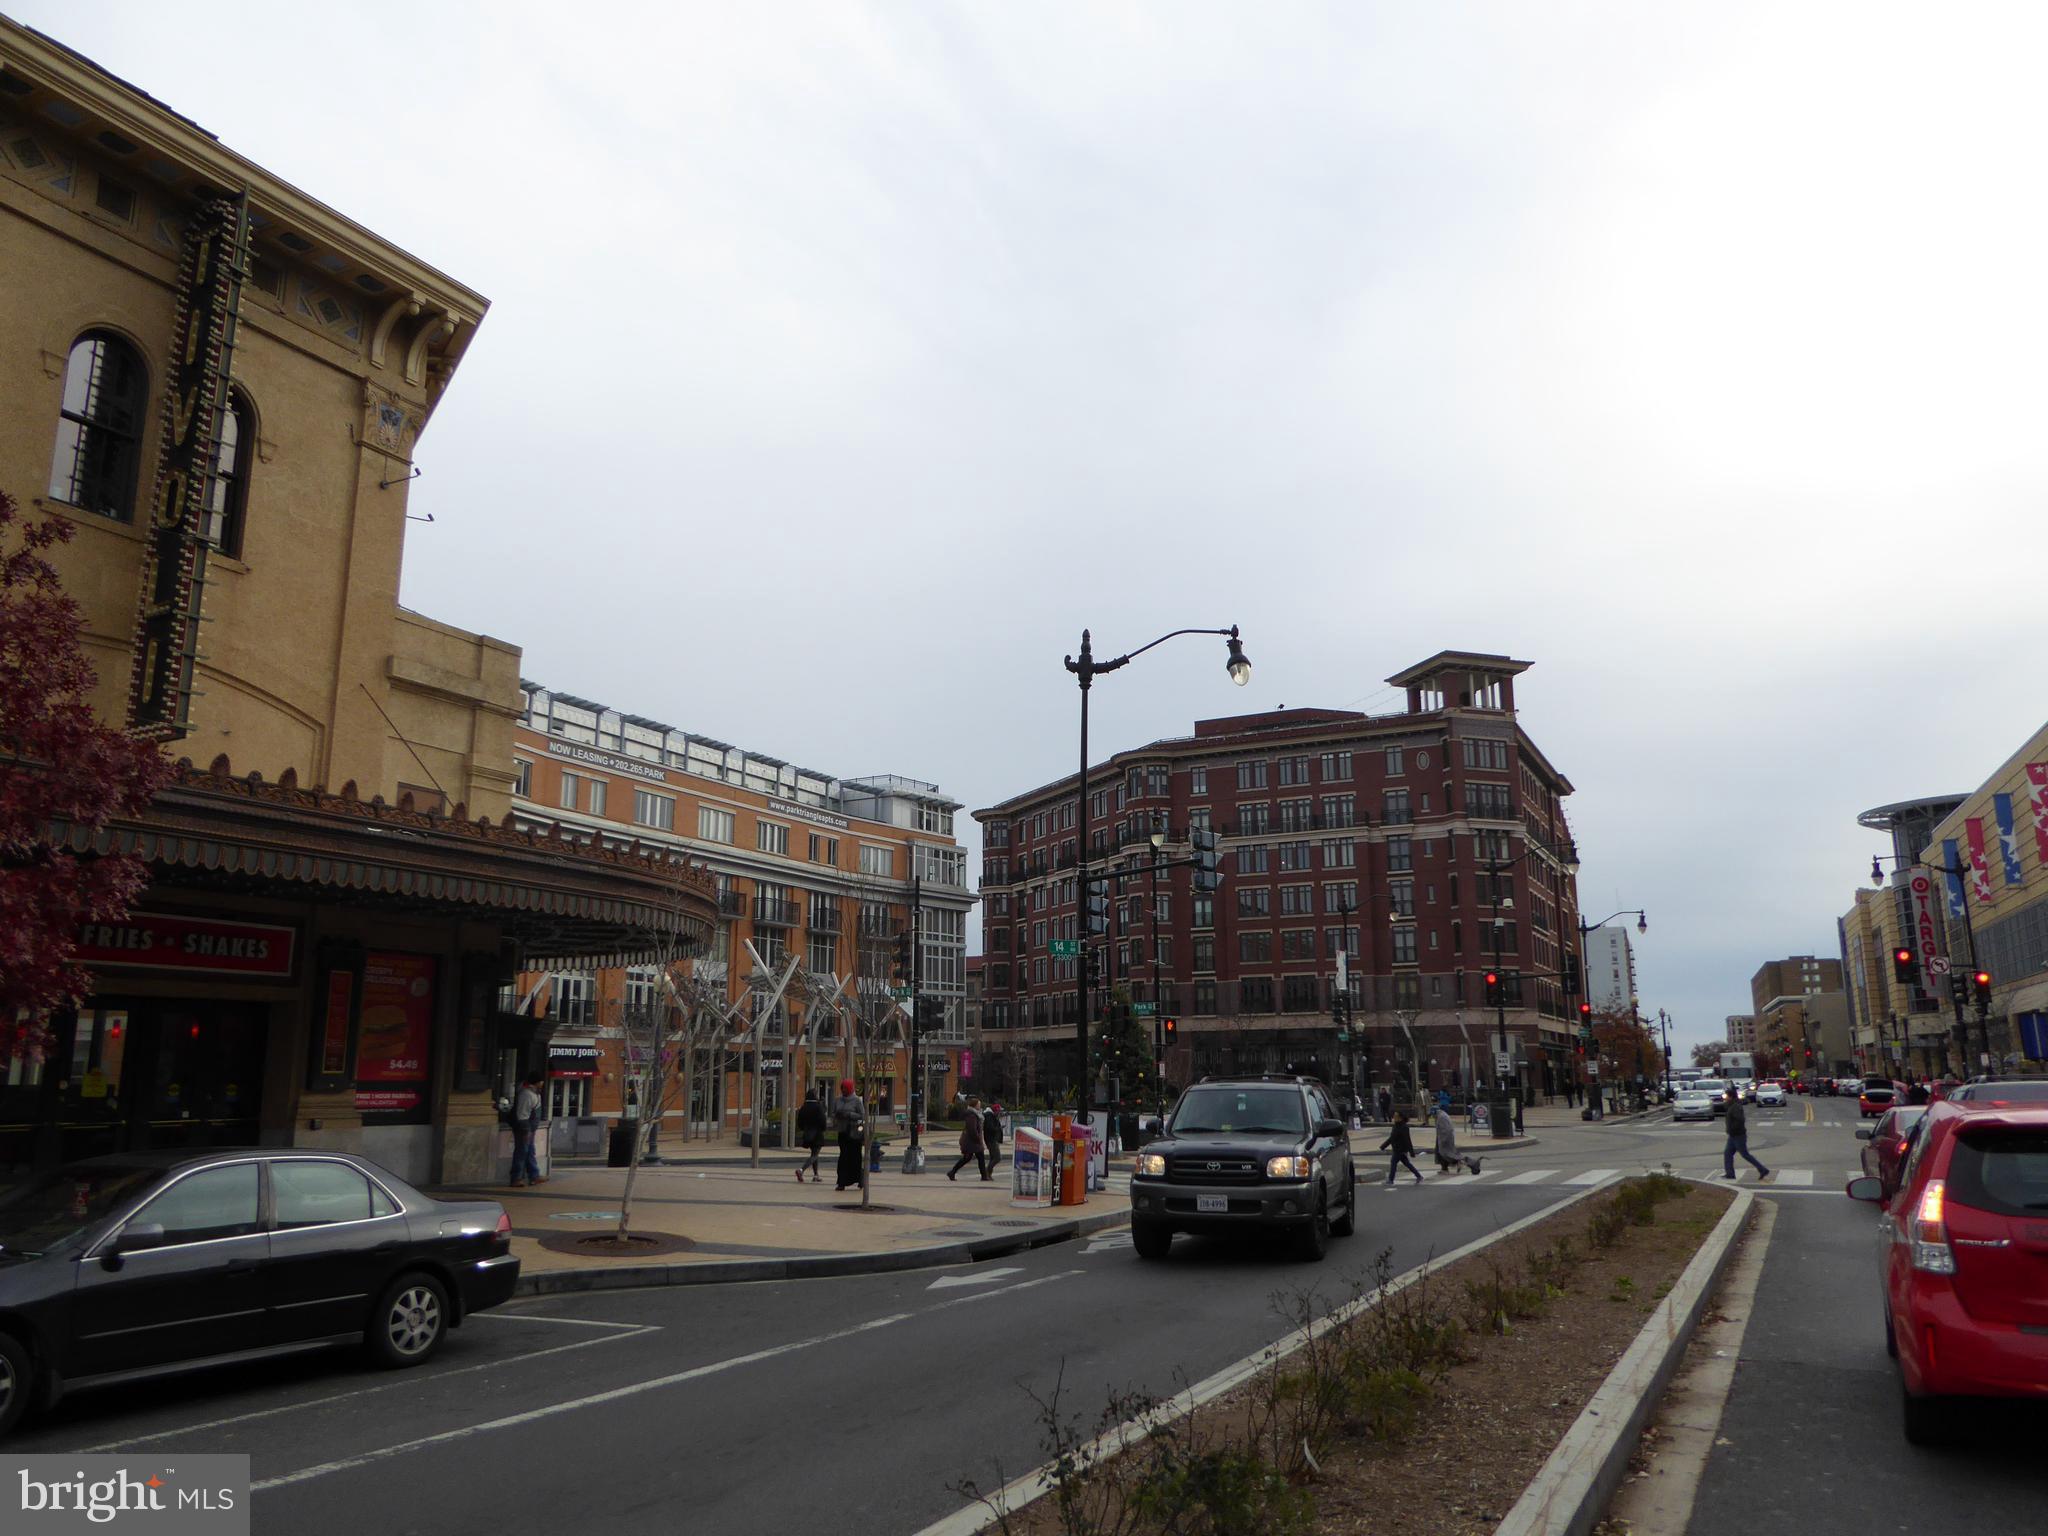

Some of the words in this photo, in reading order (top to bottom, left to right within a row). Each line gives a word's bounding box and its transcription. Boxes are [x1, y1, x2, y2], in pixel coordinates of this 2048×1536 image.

[549, 741, 572, 755] NOW
[572, 748, 608, 765] LEASING
[615, 760, 665, 780] 202.265.PARK
[769, 801, 848, 827] www.parktriangleapts.com
[81, 924, 153, 950] FRIES
[184, 933, 268, 959] SHAKES
[1054, 941, 1064, 952] 14
[549, 1048, 577, 1058] JIMMY
[578, 1048, 605, 1058] JOHN'S
[1053, 1152, 1061, 1201] blade
